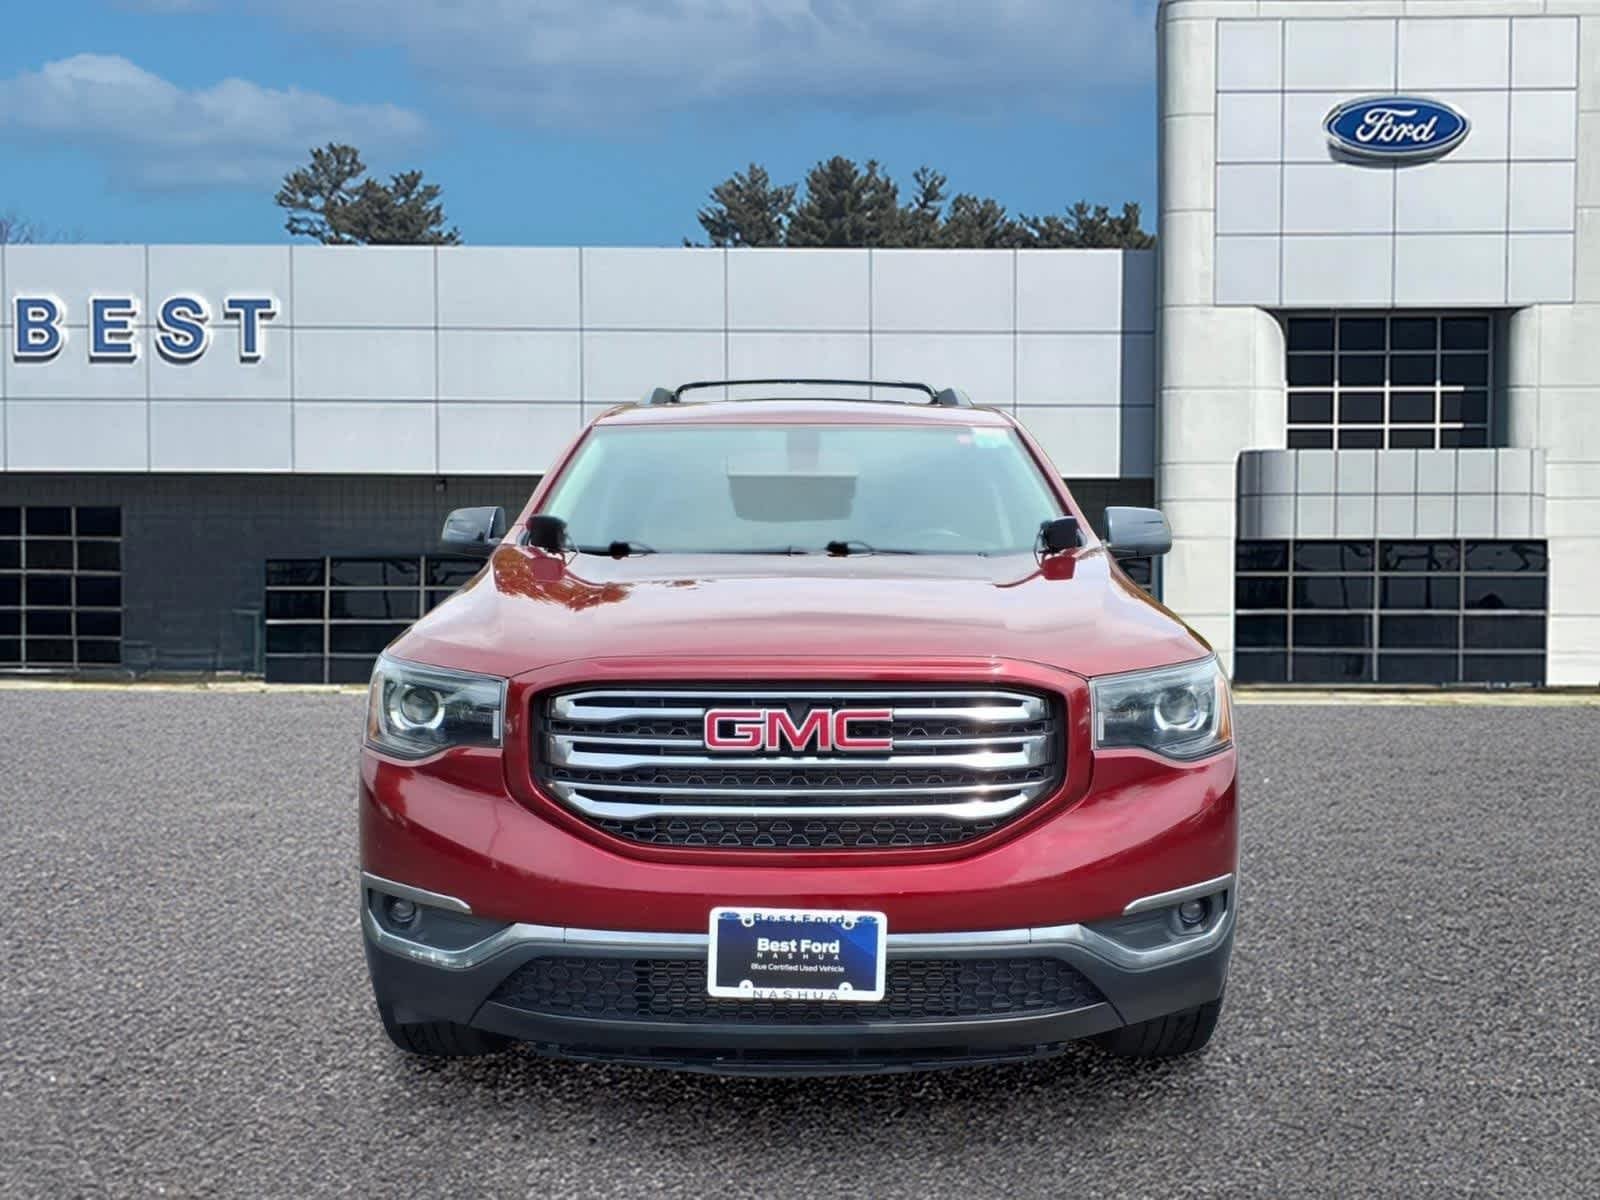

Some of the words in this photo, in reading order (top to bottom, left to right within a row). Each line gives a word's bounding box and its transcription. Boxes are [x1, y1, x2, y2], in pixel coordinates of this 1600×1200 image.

[1355, 107, 1439, 142] Ford
[13, 295, 276, 363] BEST
[704, 708, 893, 751] GMC
[753, 912, 796, 922] Best
[801, 914, 844, 924] Ford
[757, 938, 797, 952] Best
[801, 939, 840, 953] Ford
[752, 990, 839, 1000] NASHUA
